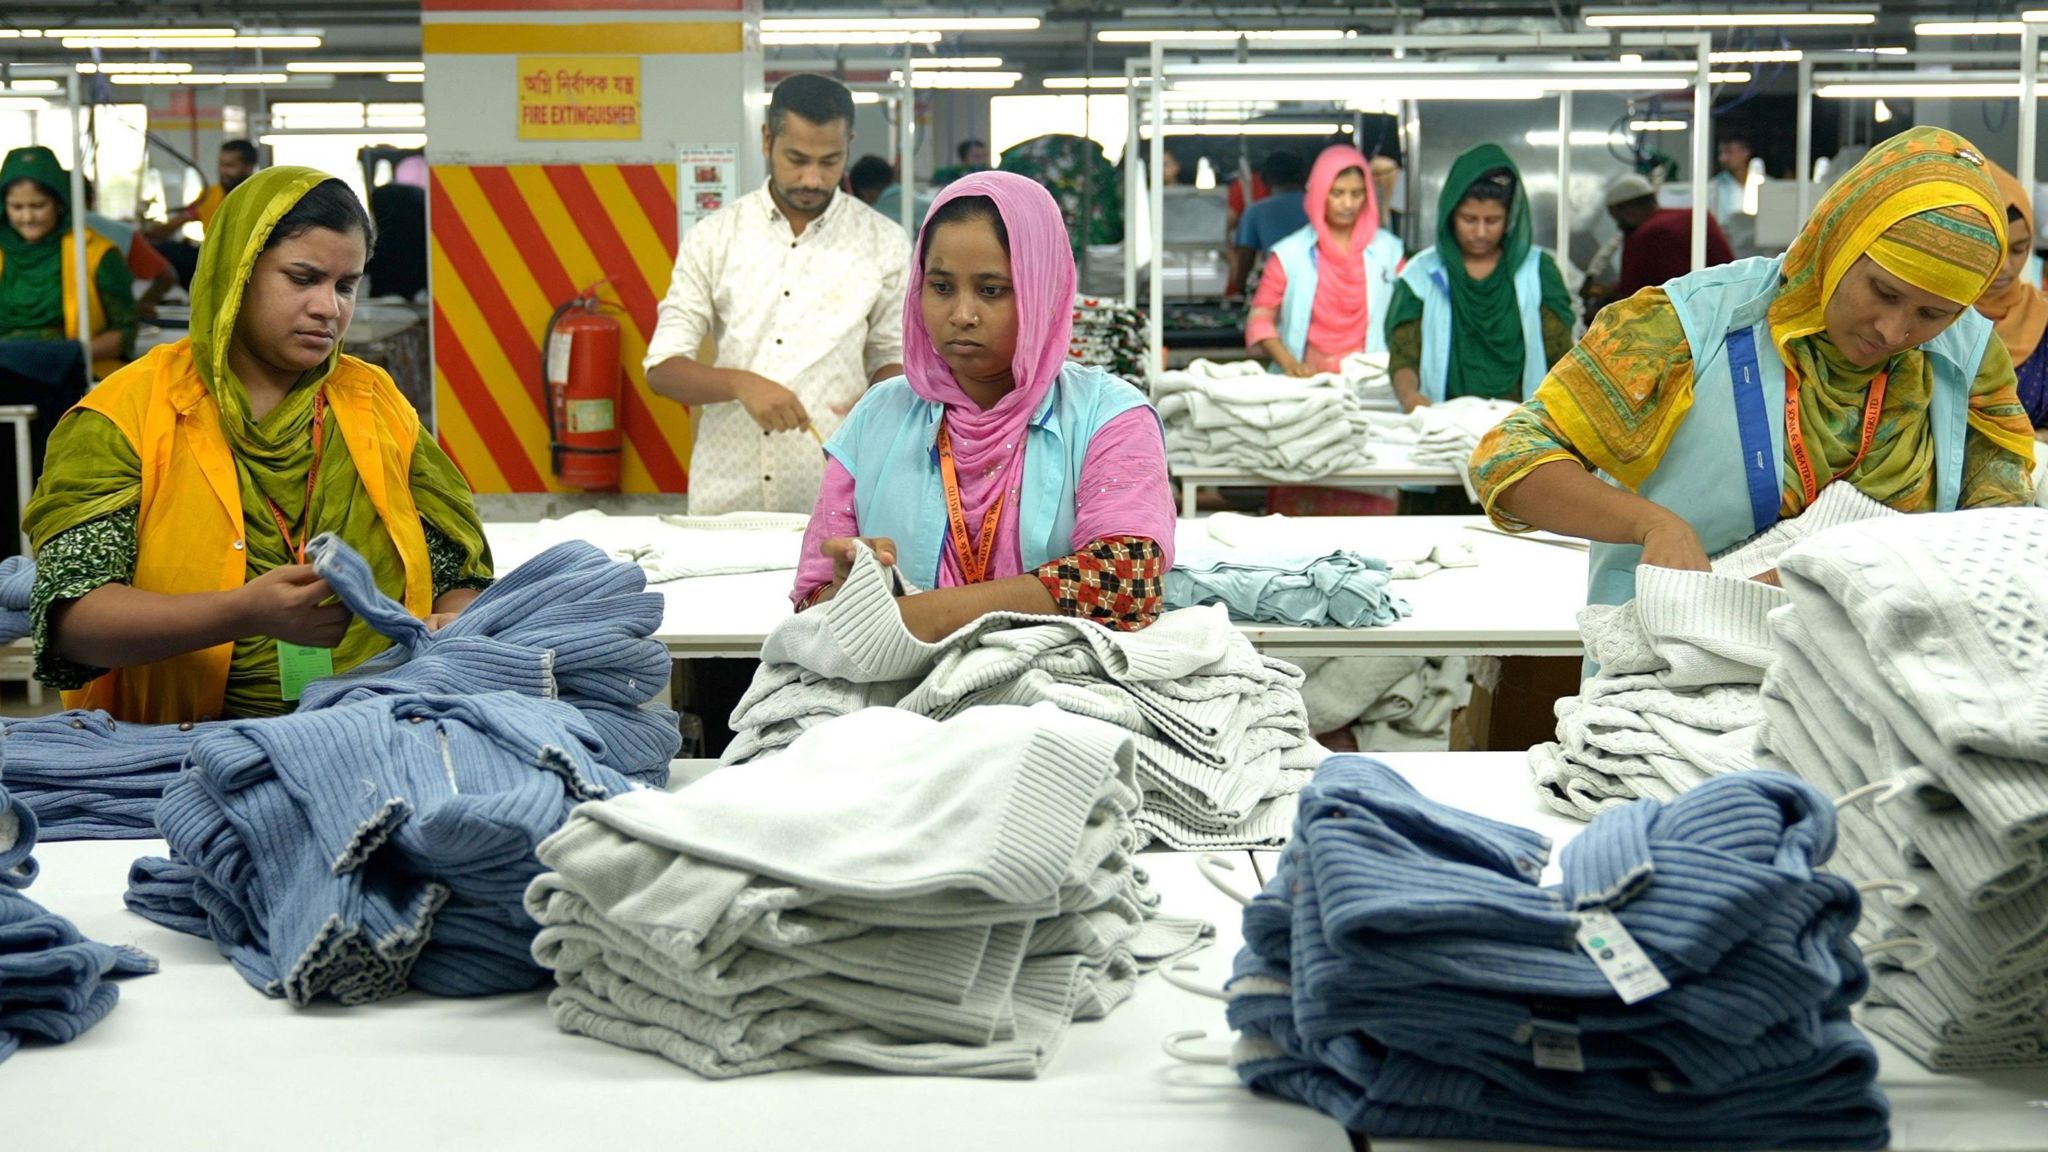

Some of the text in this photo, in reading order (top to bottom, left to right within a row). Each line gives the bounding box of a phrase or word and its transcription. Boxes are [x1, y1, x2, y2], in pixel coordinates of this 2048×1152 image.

[556, 69, 607, 94] নির্বাপক
[523, 105, 635, 124] FIRE EXTINGUISHER
[1787, 409, 1796, 432] SONIA
[951, 503, 966, 540] SWEATERS
[961, 552, 975, 576] SONIA
